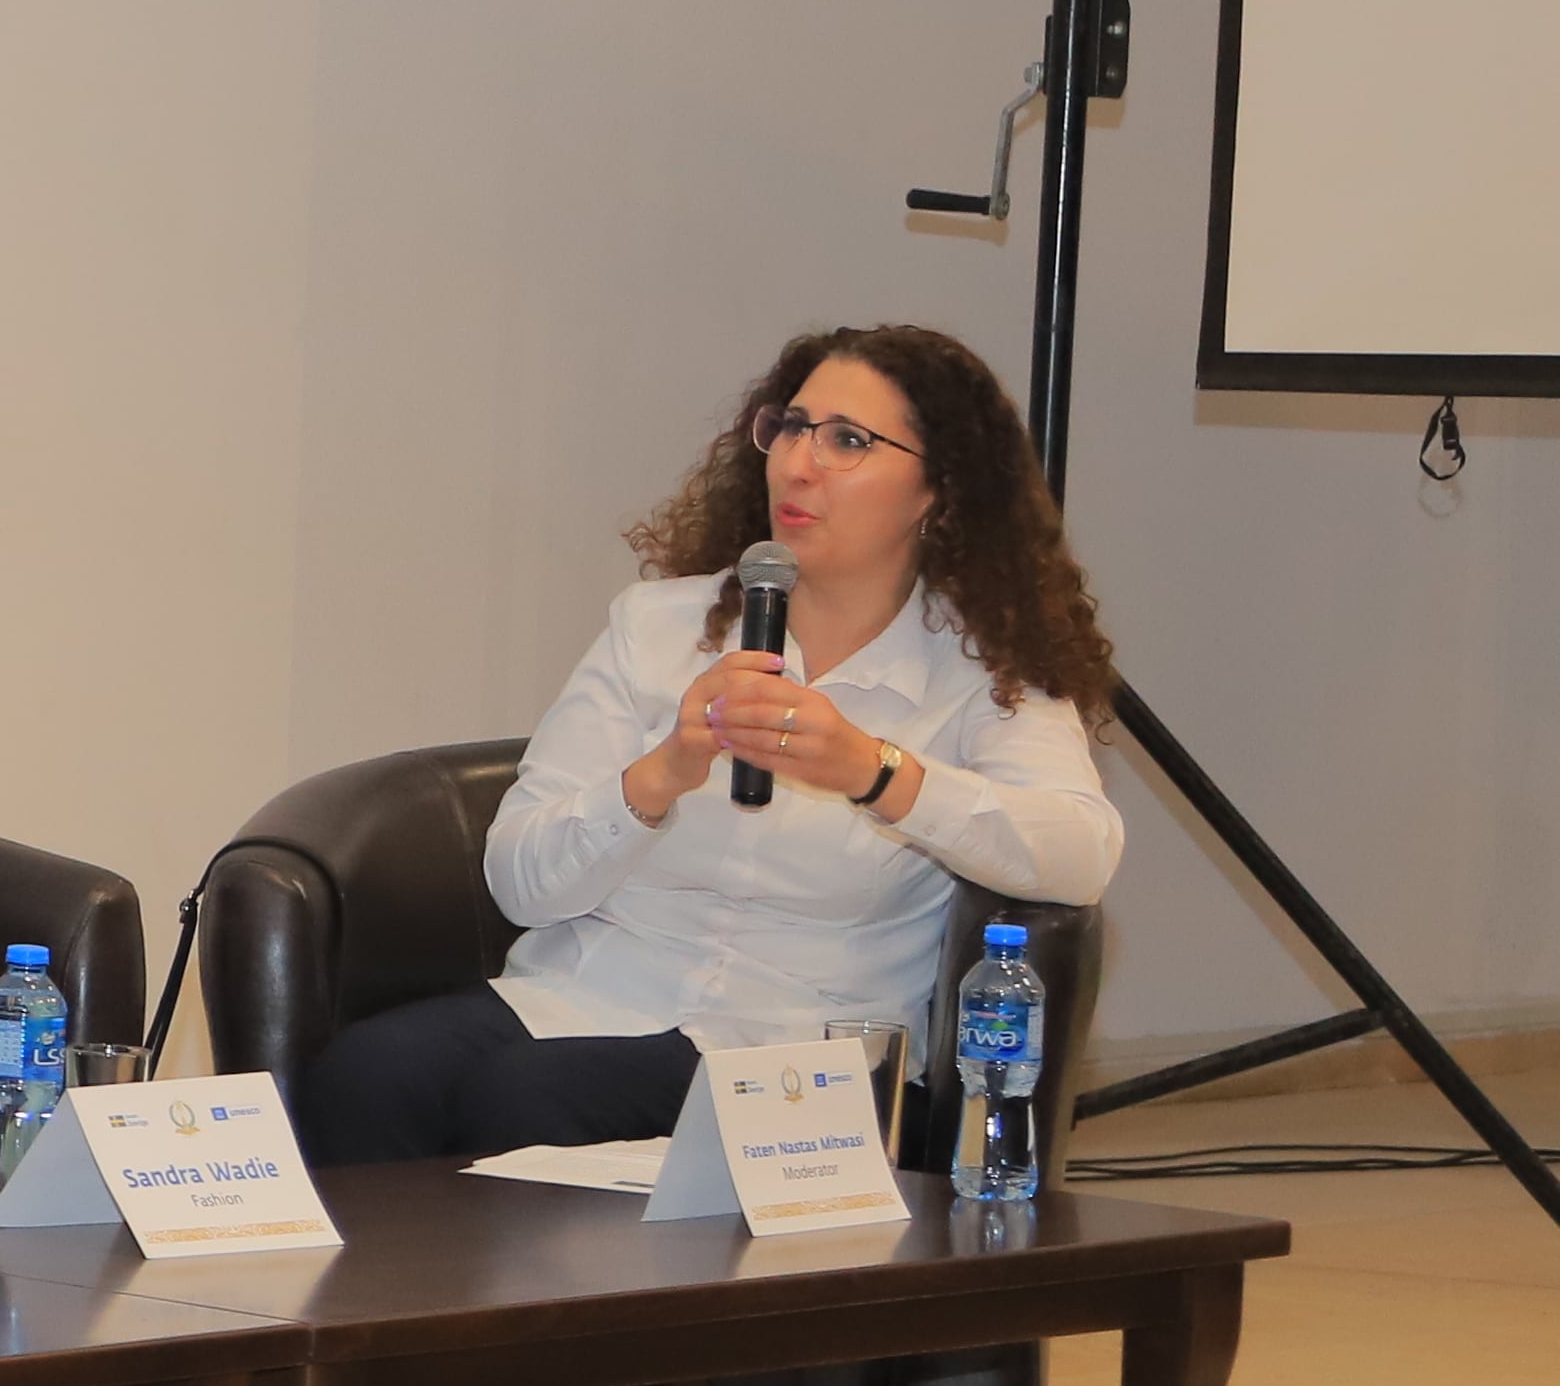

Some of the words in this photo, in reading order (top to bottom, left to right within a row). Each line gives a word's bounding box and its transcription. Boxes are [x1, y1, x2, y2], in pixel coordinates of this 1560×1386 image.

[122, 1163, 204, 1189] Sandra
[206, 1156, 280, 1182] Wadie
[191, 1192, 244, 1208] Fashion
